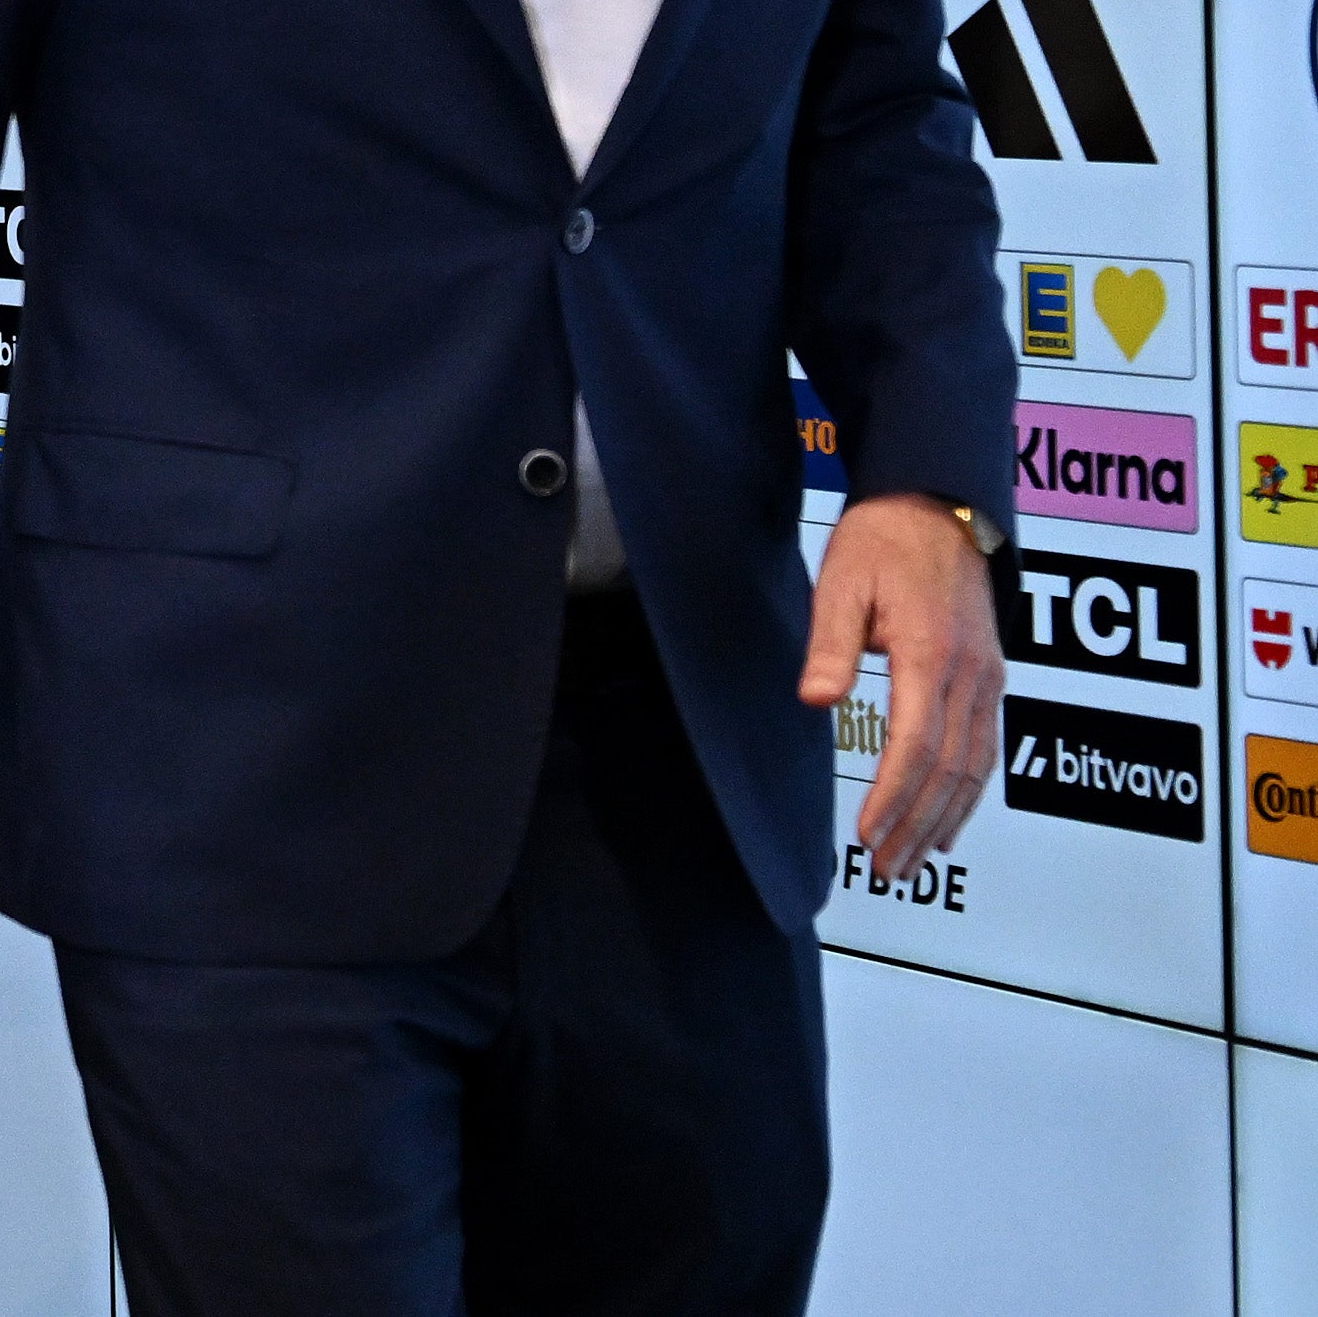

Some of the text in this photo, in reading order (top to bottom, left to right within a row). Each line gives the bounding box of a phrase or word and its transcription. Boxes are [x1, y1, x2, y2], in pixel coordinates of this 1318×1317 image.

[1011, 425, 1187, 507] Klarna
[1020, 570, 1188, 666] TCL
[1055, 737, 1199, 805] bitvavo
[843, 844, 967, 913] F.DE
